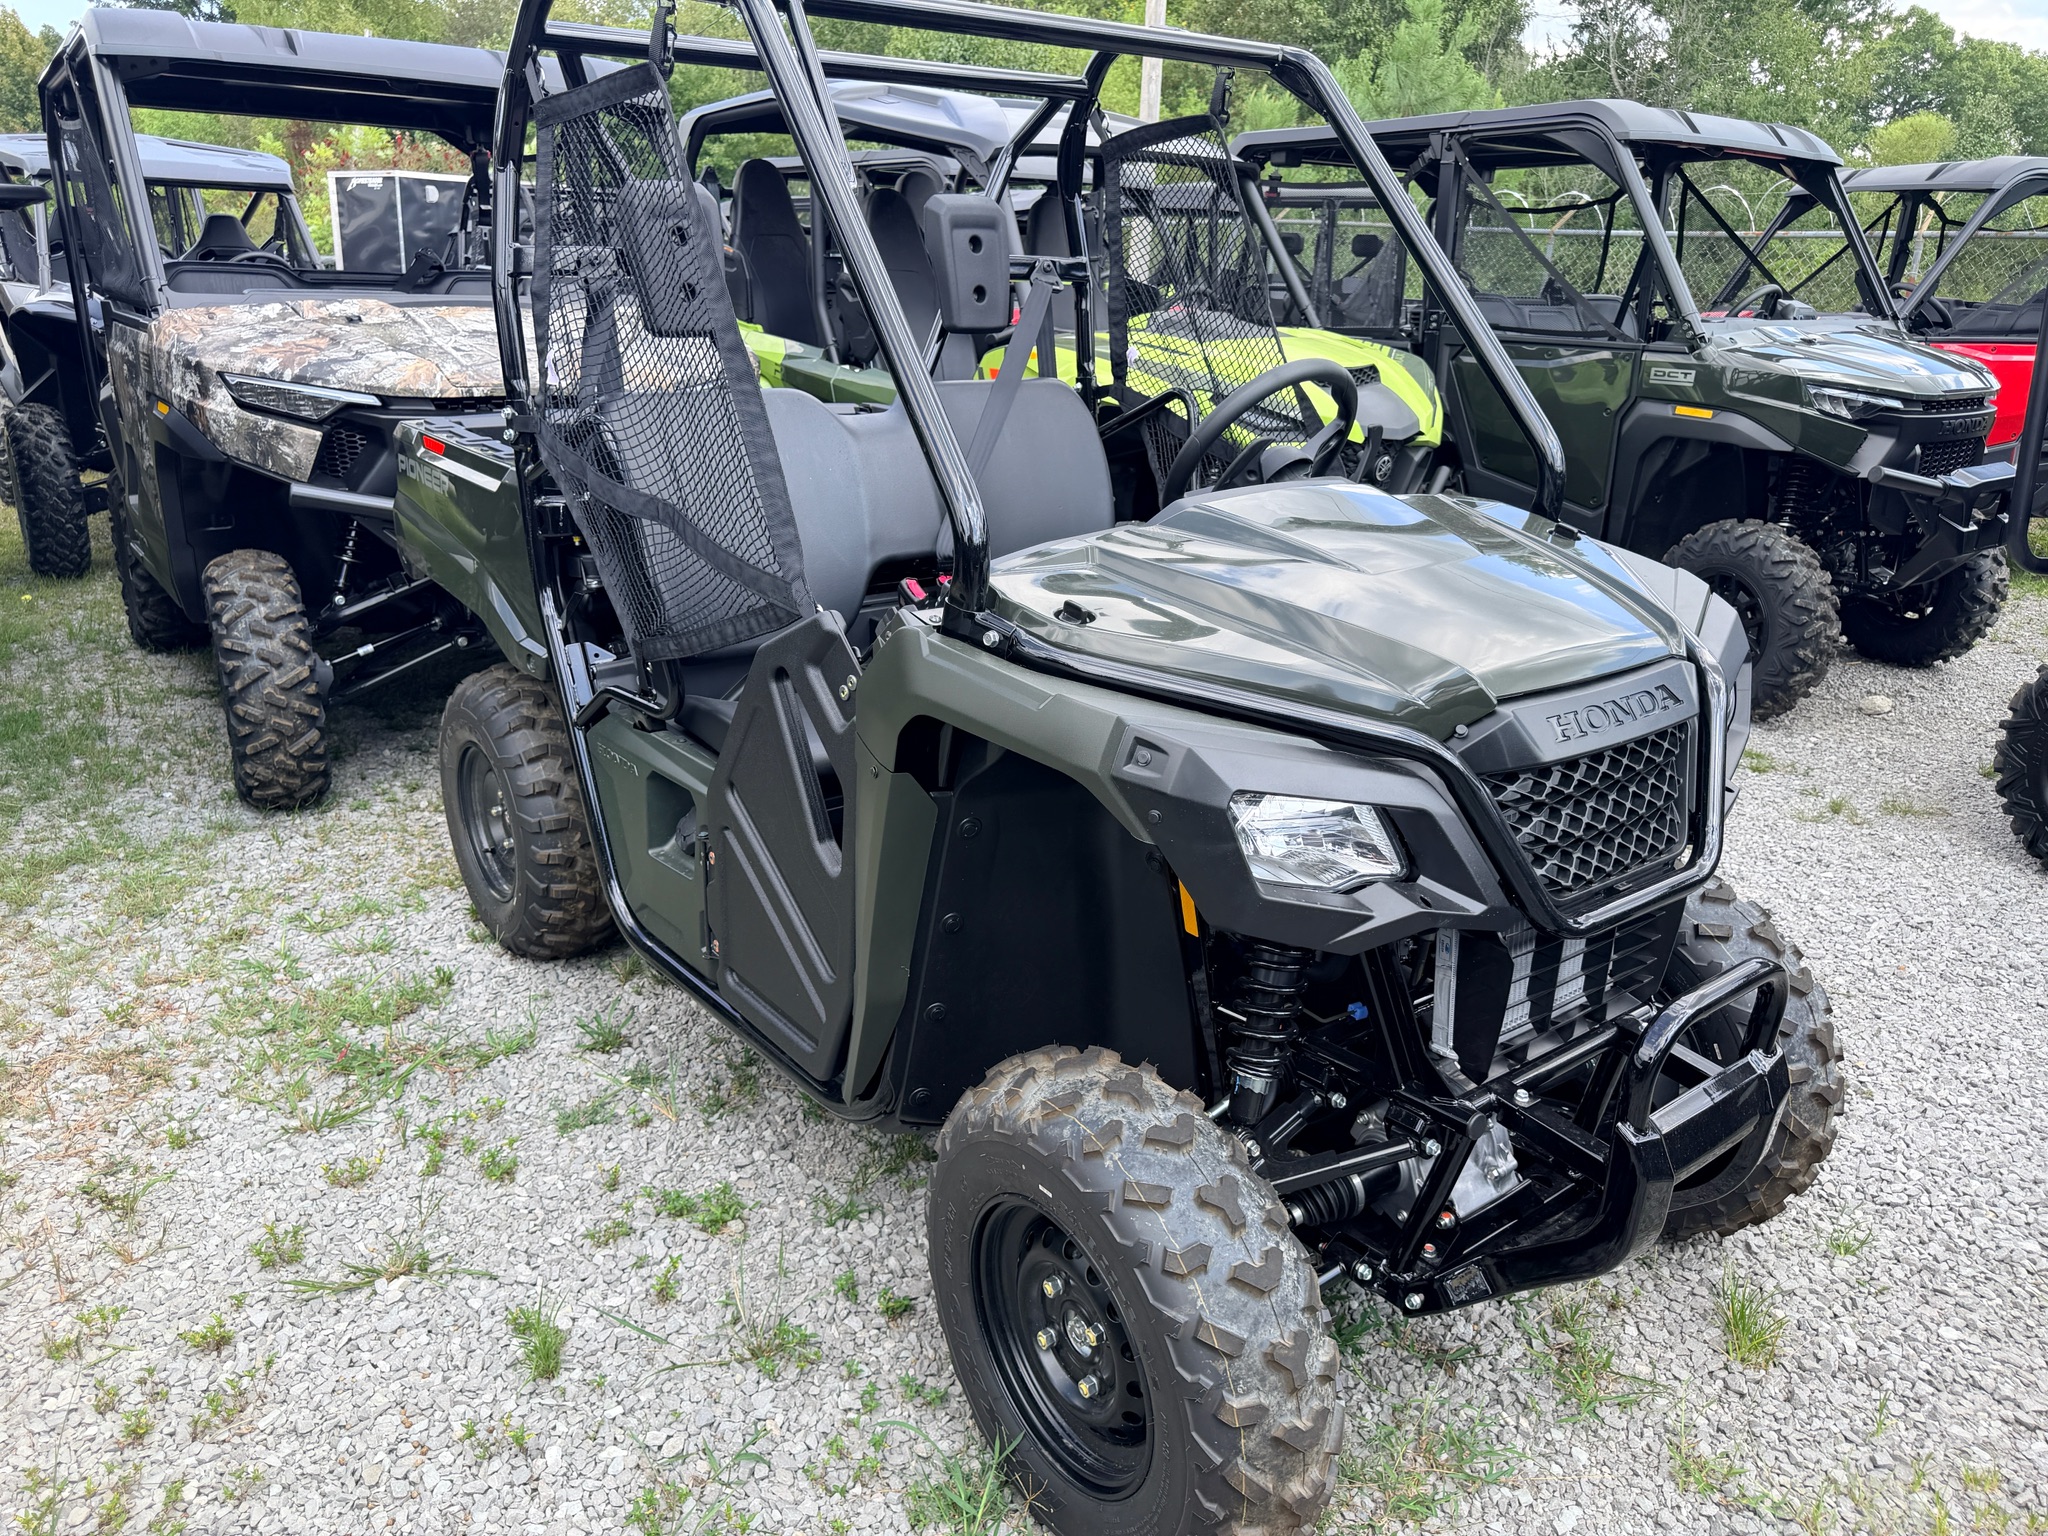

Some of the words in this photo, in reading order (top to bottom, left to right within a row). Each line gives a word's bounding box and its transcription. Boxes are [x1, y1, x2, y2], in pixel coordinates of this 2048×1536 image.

[1653, 370, 1693, 380] DCT
[1937, 415, 1989, 435] HONDA
[397, 452, 449, 498] PIONEER
[1546, 683, 1685, 743] HONDA
